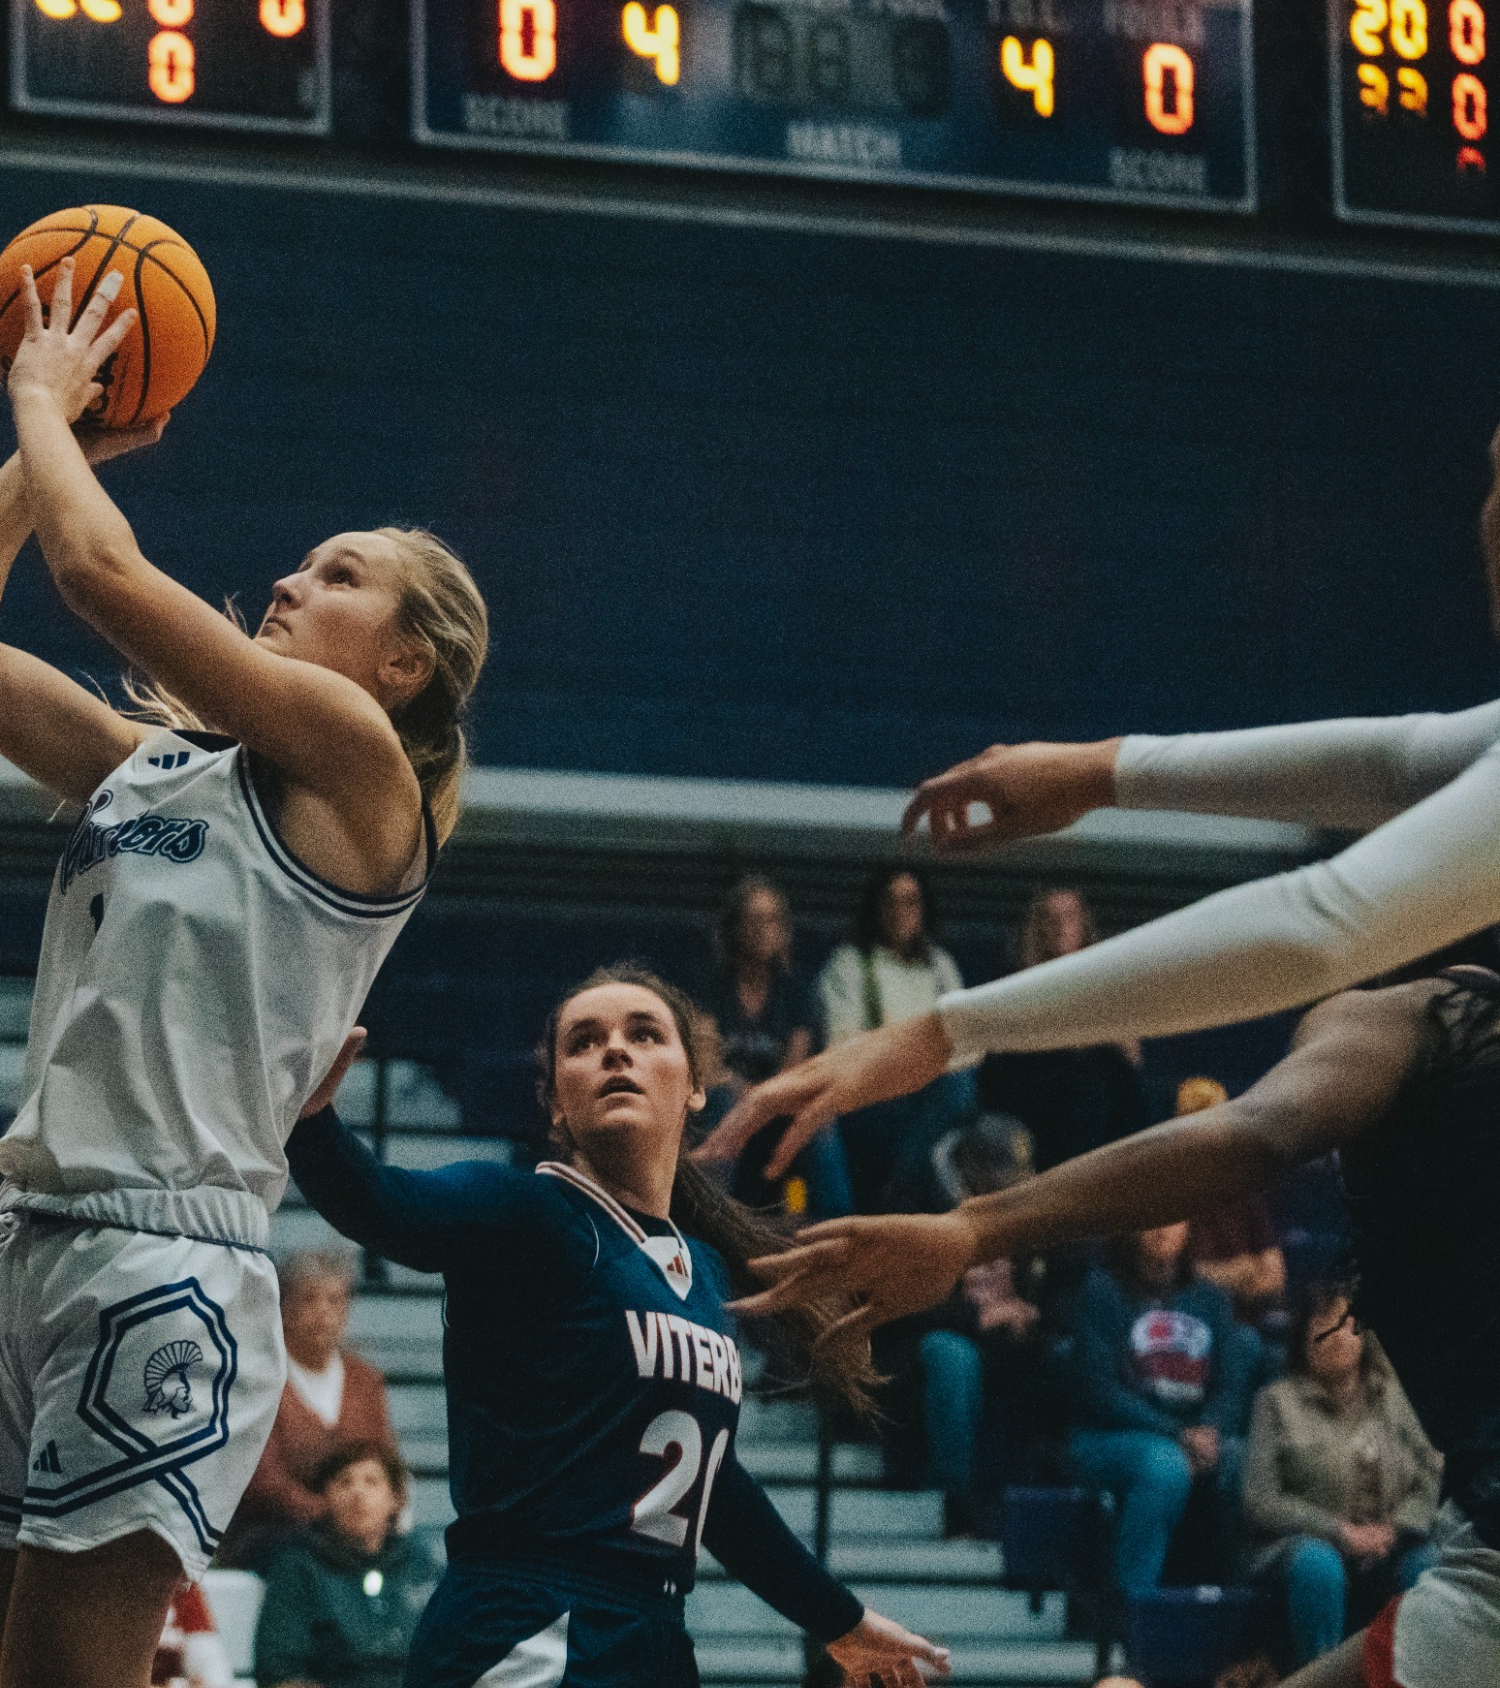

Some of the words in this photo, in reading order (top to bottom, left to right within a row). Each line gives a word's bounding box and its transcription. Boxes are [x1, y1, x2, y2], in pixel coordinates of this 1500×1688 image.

[147, 30, 195, 103] 0
[621, 1, 680, 86] 4
[1000, 35, 1055, 118] 4
[1142, 42, 1194, 135] 0
[1451, 72, 1488, 141] 0
[624, 1309, 742, 1405] VITERB
